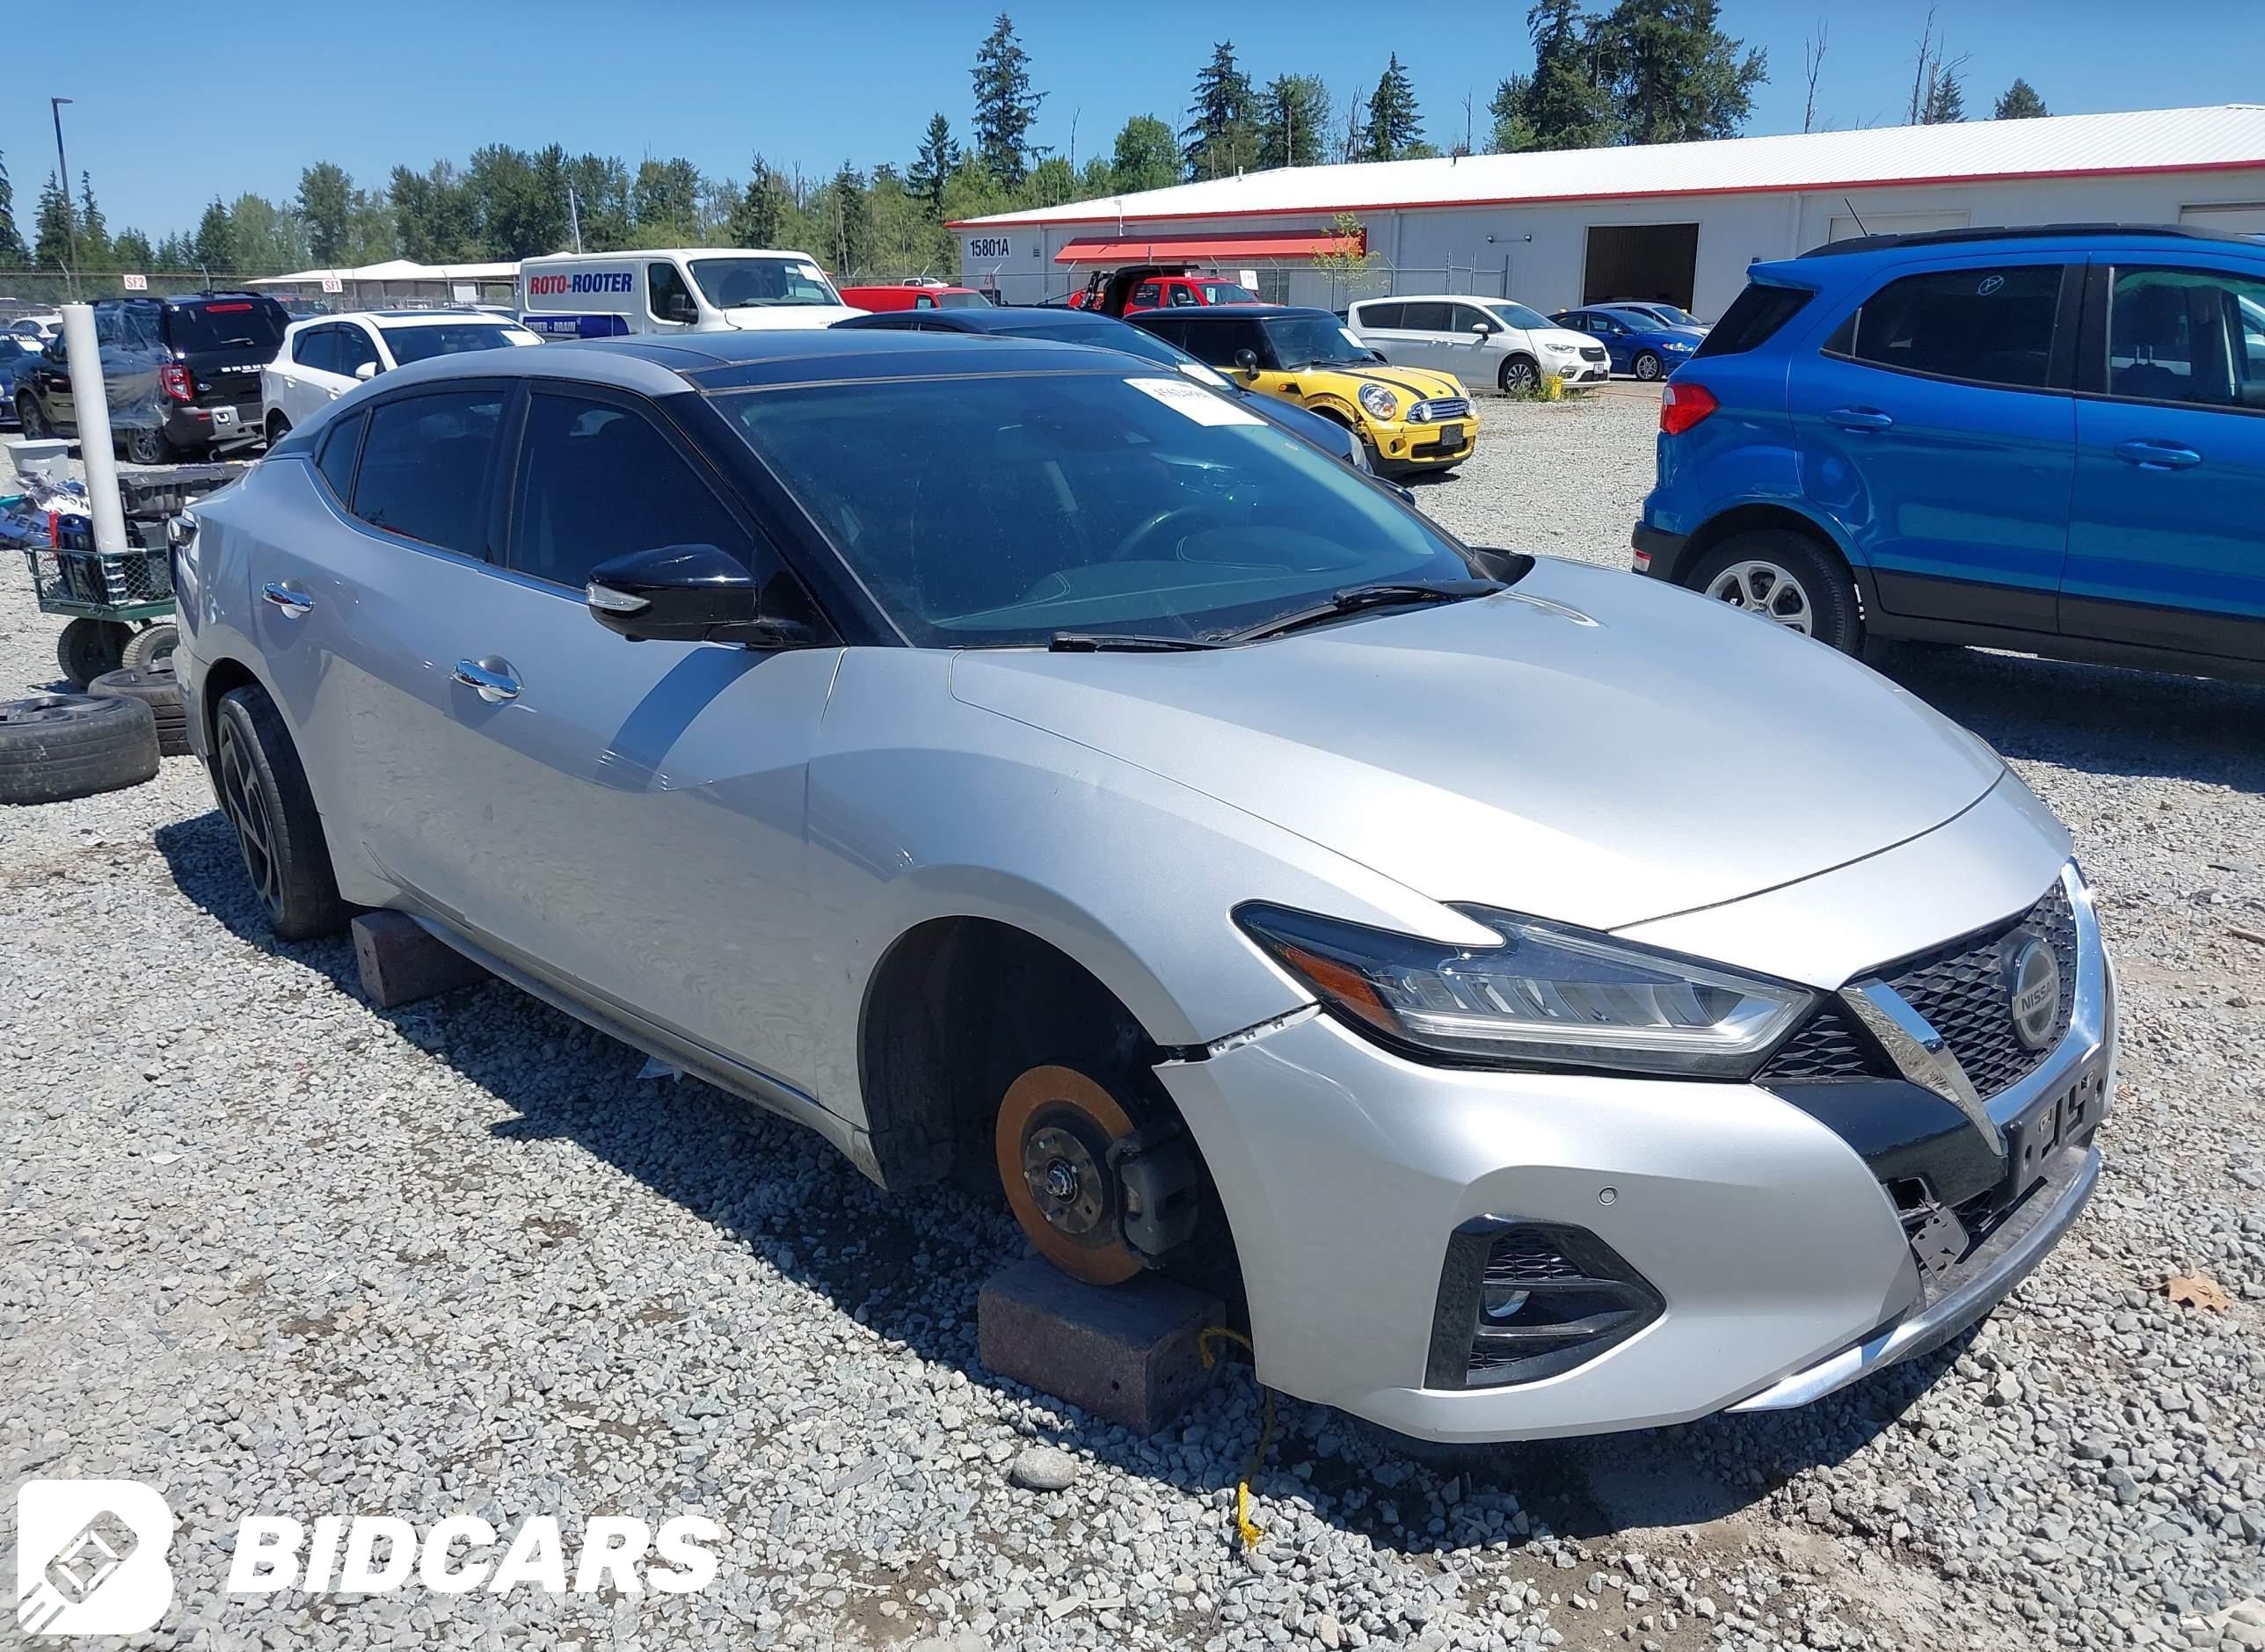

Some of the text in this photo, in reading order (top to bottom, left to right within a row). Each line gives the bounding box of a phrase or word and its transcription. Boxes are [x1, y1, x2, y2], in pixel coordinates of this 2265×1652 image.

[970, 238, 1009, 257] 15801A
[126, 276, 145, 288] SF2
[325, 280, 339, 291] SF1
[530, 273, 633, 295] ROTO-ROOTER
[554, 322, 576, 332] DRAIN
